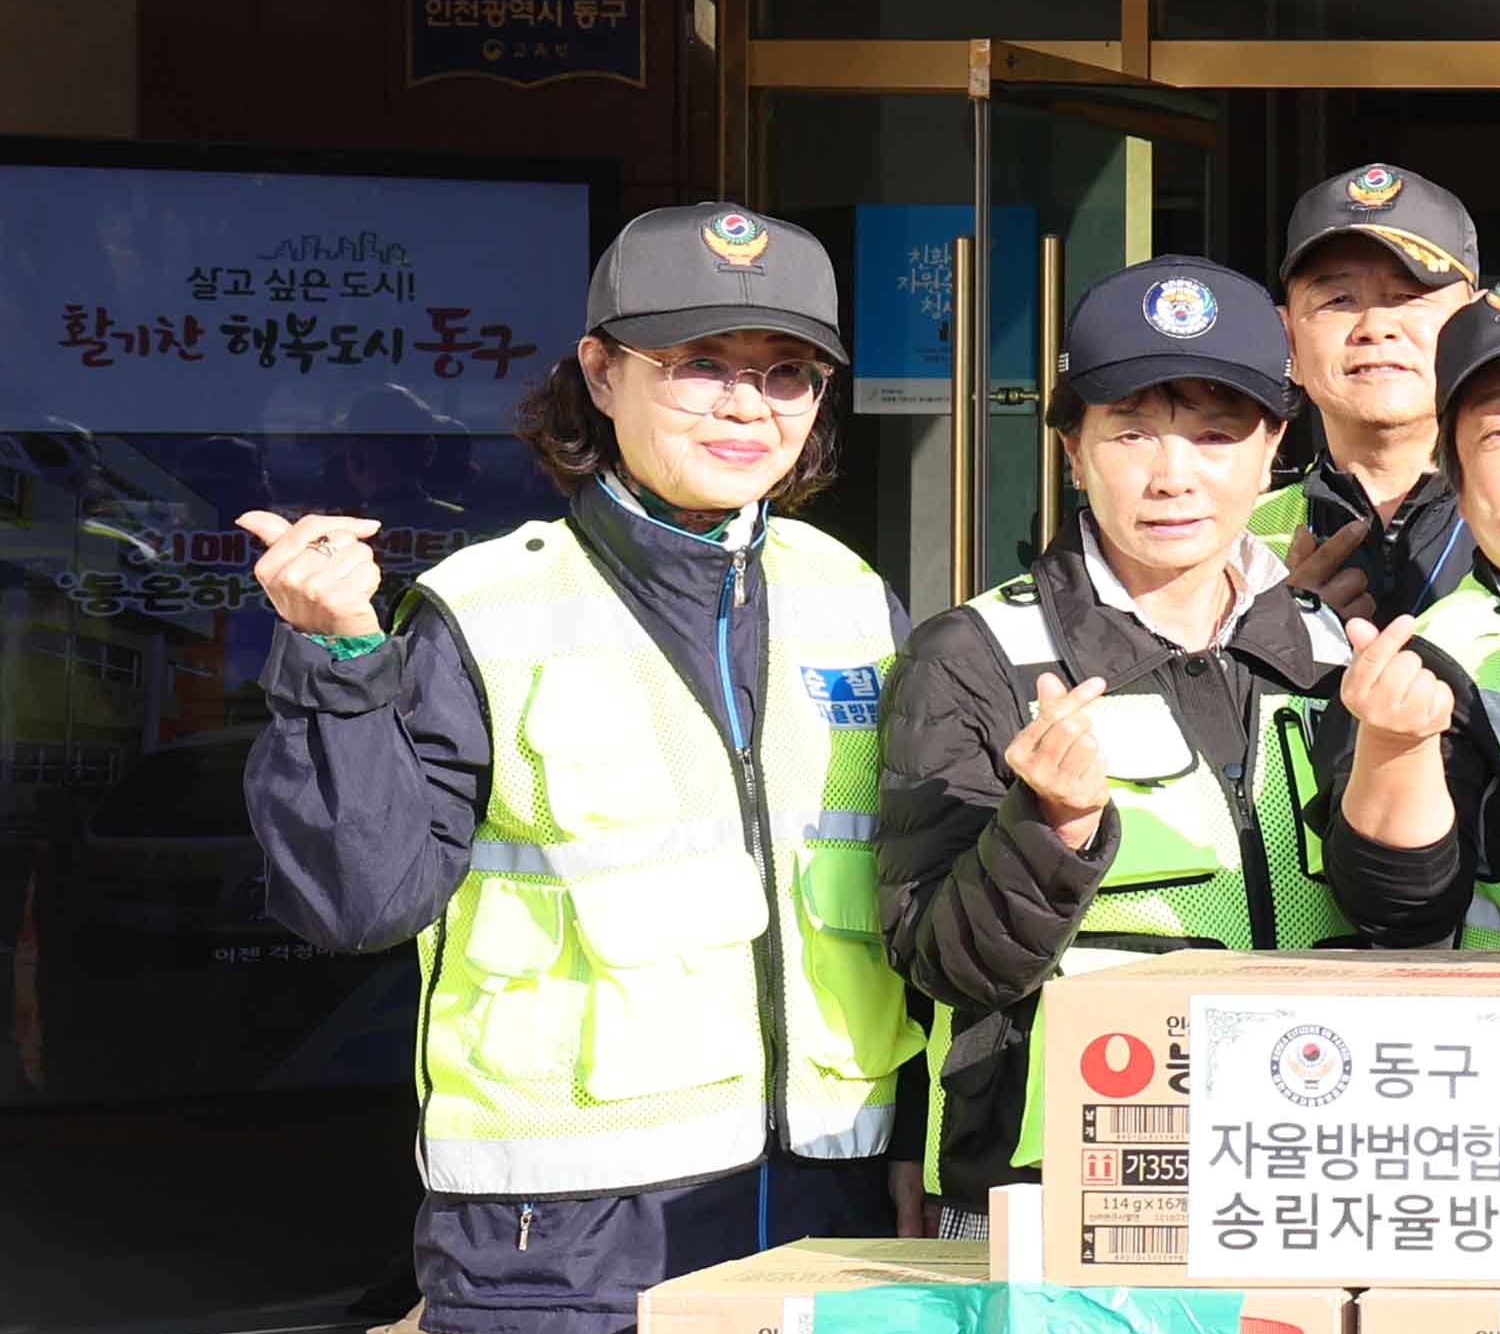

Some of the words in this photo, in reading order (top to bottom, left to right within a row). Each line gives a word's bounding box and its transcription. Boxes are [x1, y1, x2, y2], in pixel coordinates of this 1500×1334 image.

[573, 0, 628, 29] 동구
[187, 267, 254, 301] 살고
[265, 268, 330, 302] 싶은
[341, 269, 415, 302] 도시!
[59, 303, 206, 367] 활기찬
[220, 313, 404, 374] 행복도시
[415, 308, 536, 379] 동구
[1369, 1041, 1479, 1100] 동구
